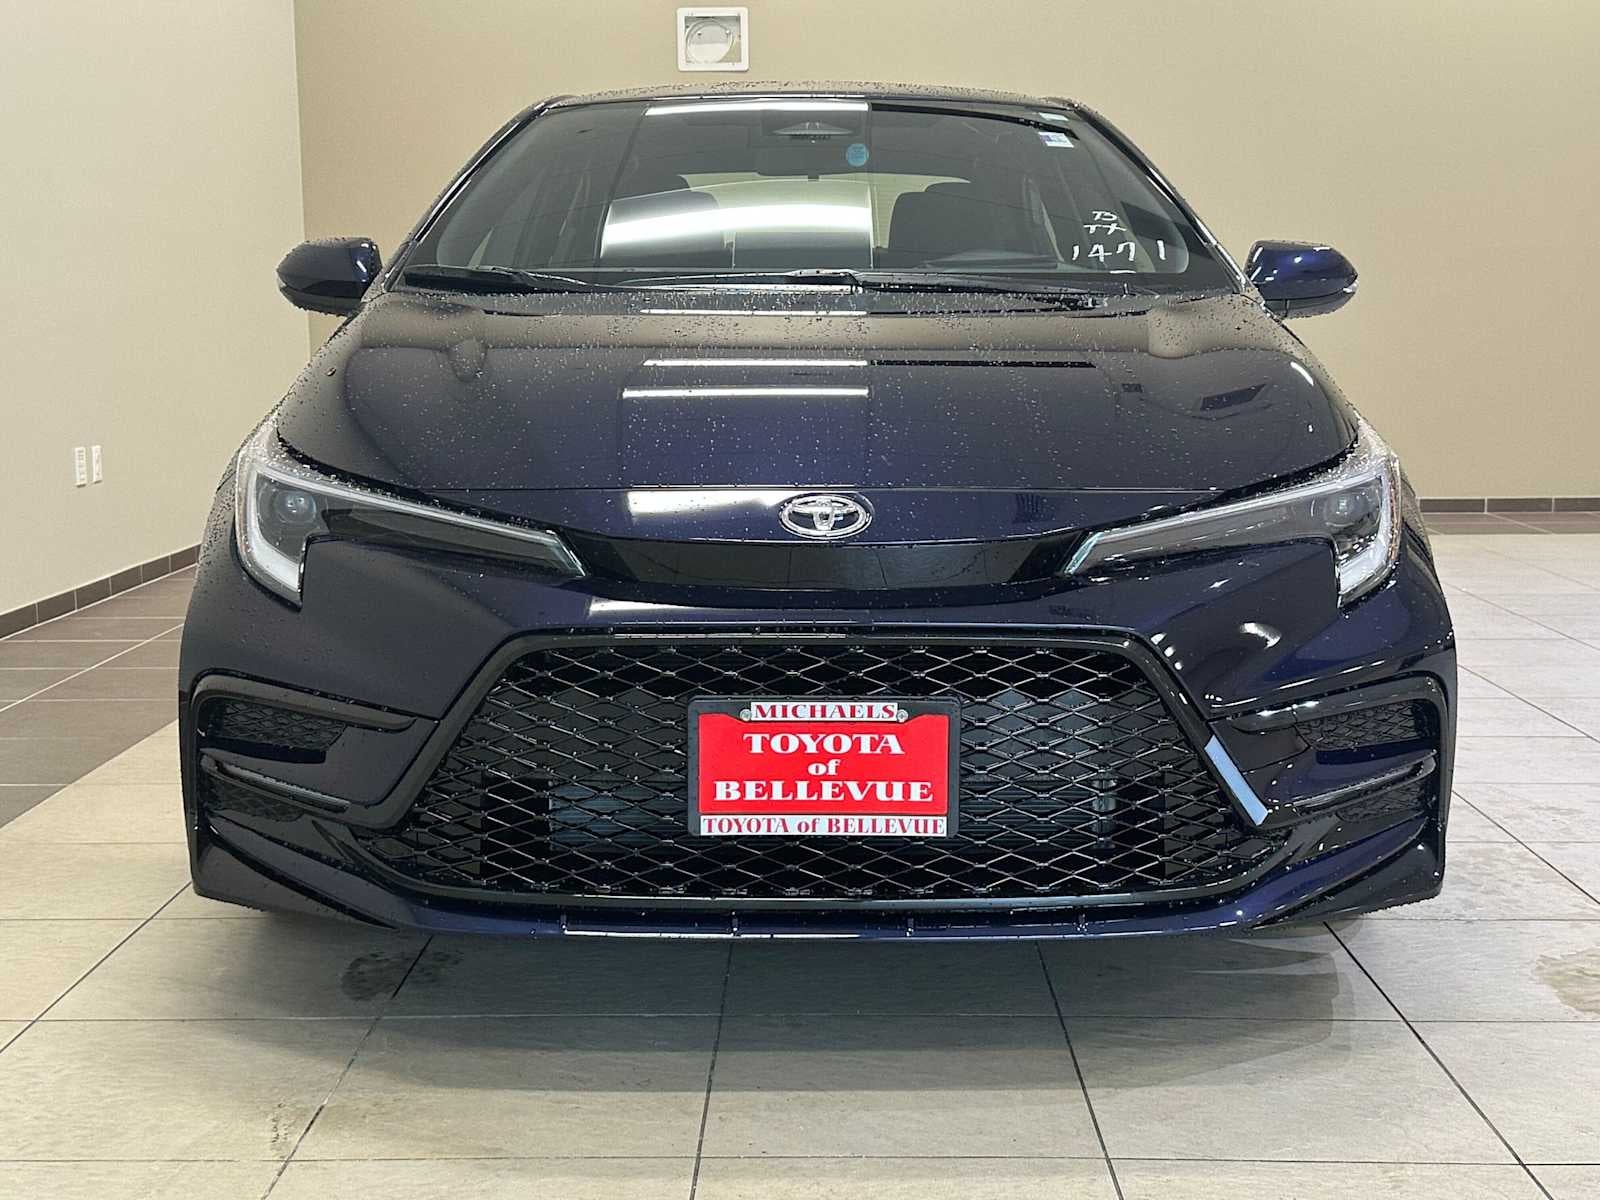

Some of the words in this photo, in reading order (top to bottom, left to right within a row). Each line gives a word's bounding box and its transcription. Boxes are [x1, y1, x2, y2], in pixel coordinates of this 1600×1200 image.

[754, 704, 897, 719] MICHAELS
[743, 733, 905, 755] TOYOTA
[807, 759, 841, 776] of
[714, 781, 934, 802] BELLEVUE
[703, 818, 791, 834] TOYOTA
[797, 817, 821, 834] of
[828, 818, 945, 835] BELLEVUE
